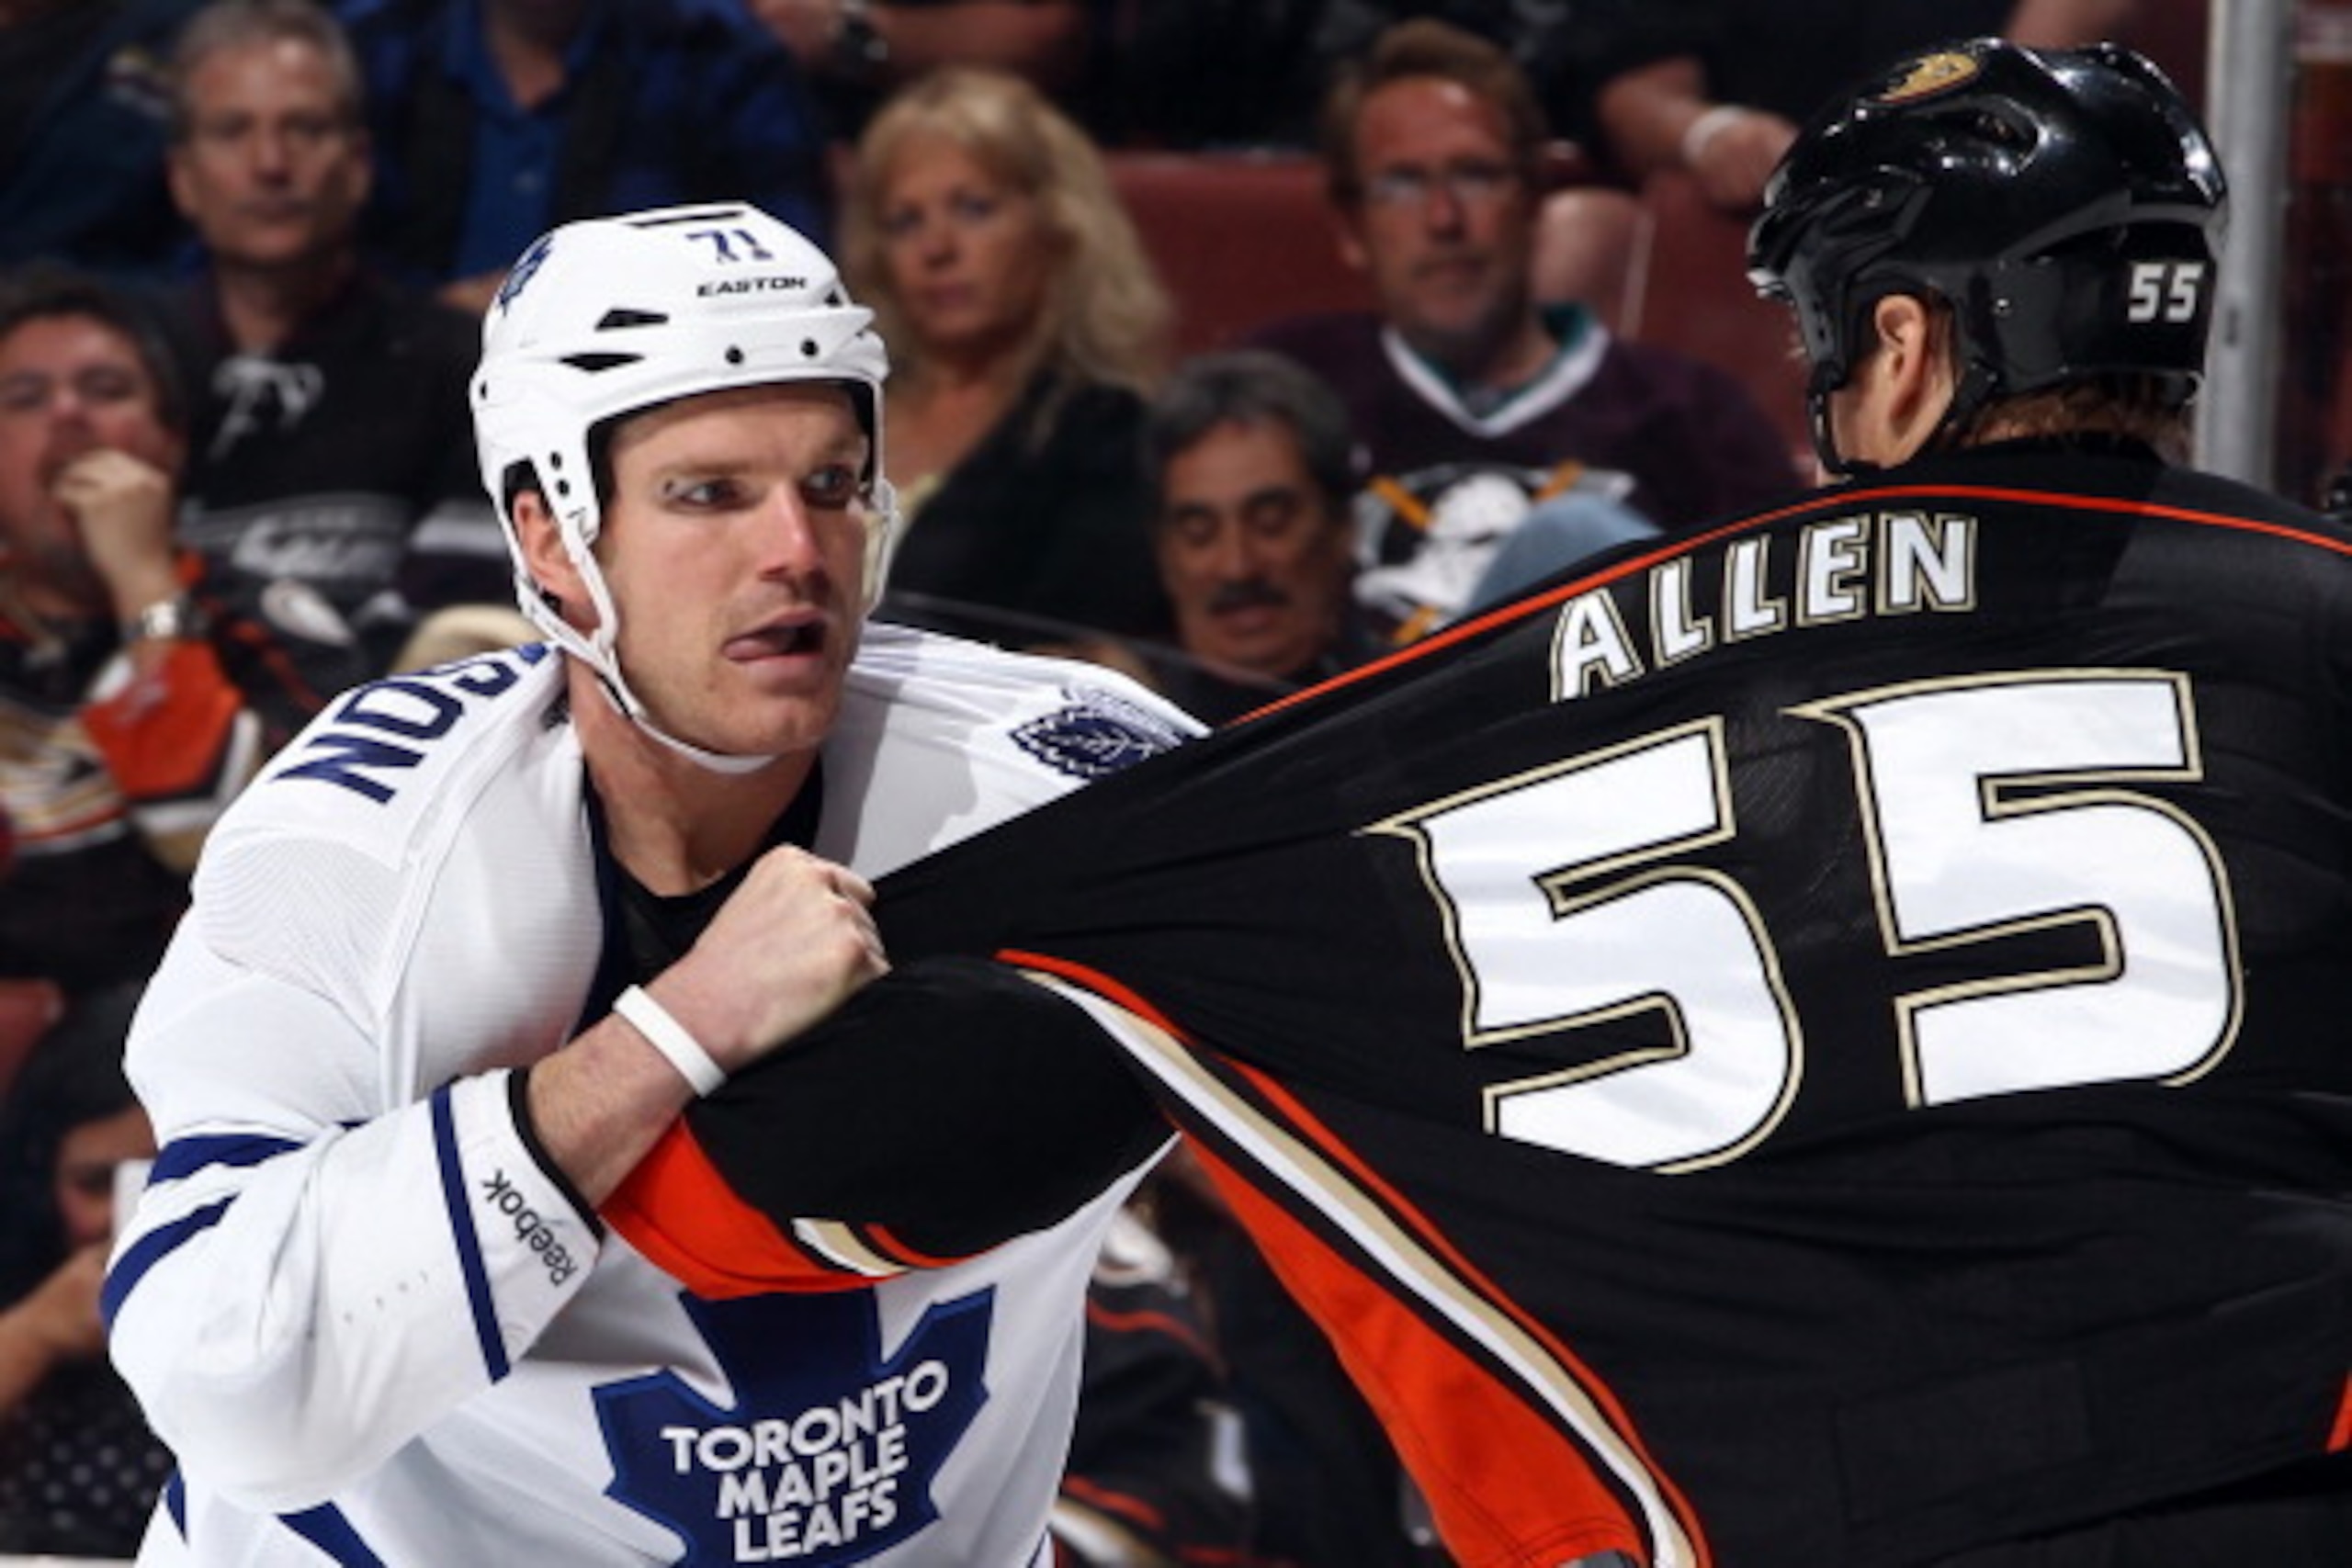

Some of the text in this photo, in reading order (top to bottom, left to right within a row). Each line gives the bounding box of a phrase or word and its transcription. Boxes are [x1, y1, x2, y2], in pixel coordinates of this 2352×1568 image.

[685, 230, 773, 262] 71
[697, 276, 808, 297] EASTON
[2128, 263, 2204, 323] 55
[1551, 511, 1977, 704] ALLEN
[1354, 667, 2244, 1174] 55
[482, 1168, 579, 1287] Reebok
[659, 1359, 950, 1474] TORONTO
[717, 1424, 909, 1518] MAPLE
[734, 1478, 898, 1562] LEAFS
